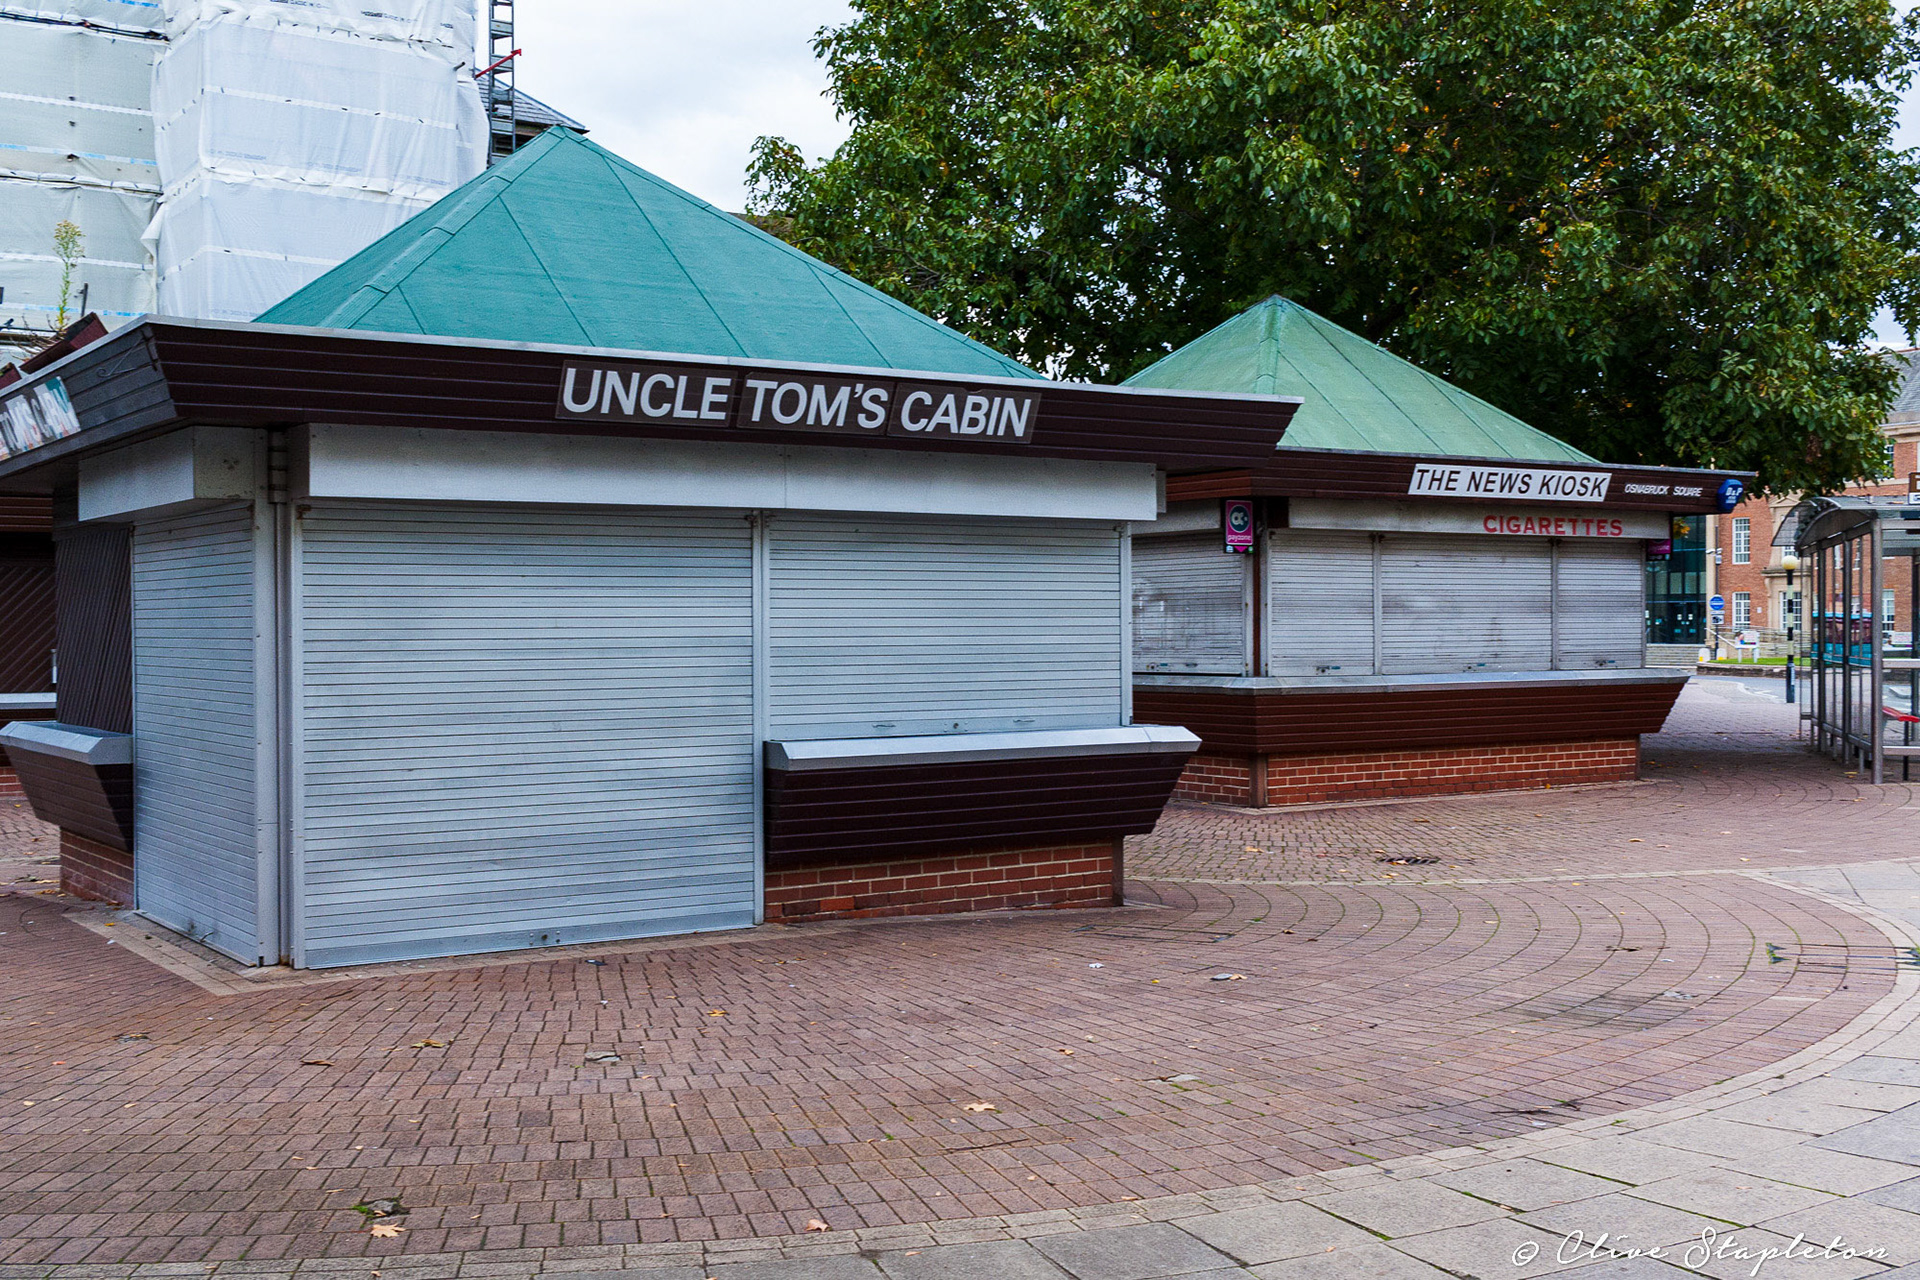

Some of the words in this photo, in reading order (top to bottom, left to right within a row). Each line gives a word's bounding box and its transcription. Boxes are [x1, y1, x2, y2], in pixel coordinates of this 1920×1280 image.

[562, 367, 732, 420] UNCLE
[745, 379, 889, 430] TOM'S
[900, 390, 1032, 438] CABIN
[1416, 468, 1460, 492] THE
[1466, 470, 1533, 495] NEWS
[1538, 474, 1609, 498] KIOSK
[1672, 486, 1703, 497] SQUARE
[1483, 515, 1623, 537] CIGARETTES
